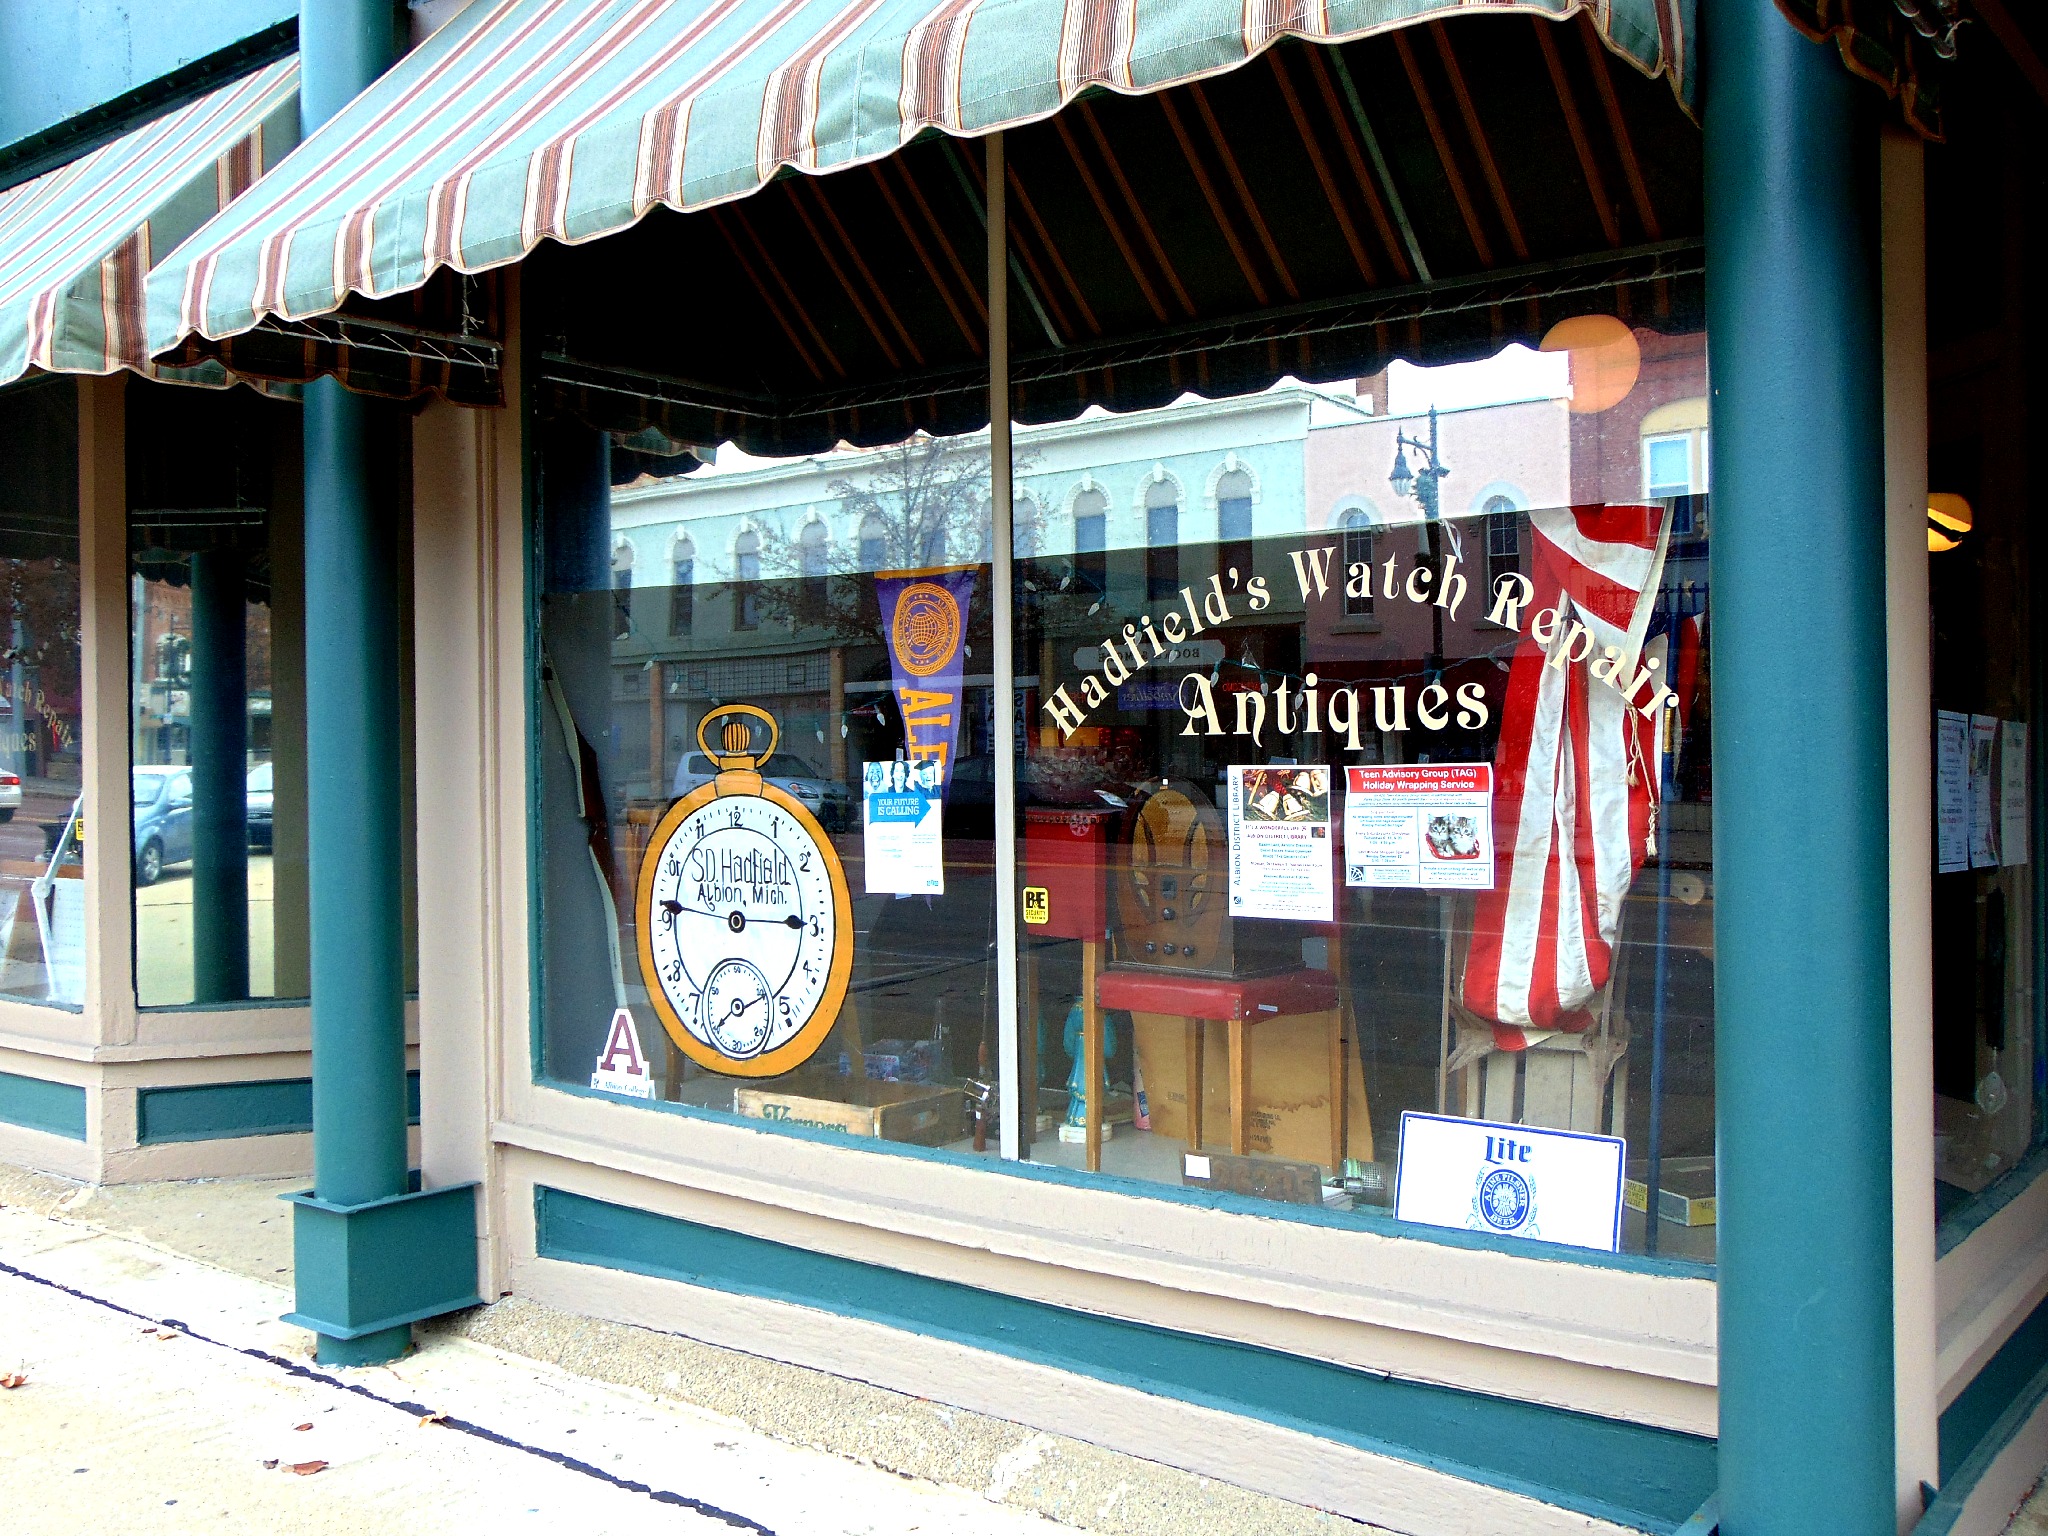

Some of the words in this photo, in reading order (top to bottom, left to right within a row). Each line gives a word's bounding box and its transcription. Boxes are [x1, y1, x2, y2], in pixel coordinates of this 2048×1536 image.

[1043, 567, 1271, 740] Hadfield's
[1287, 547, 1468, 622] Watch
[1484, 571, 1680, 722] Repair
[1178, 672, 1489, 751] Antiques
[1359, 770, 1380, 779] Teen
[1382, 770, 1420, 779] Advisory
[1421, 769, 1450, 778] Group
[1451, 769, 1477, 779] (TAG)
[1363, 780, 1394, 790] Holiday
[1396, 780, 1439, 790] Wrapping
[1440, 780, 1475, 789] Service
[877, 798, 893, 806] YOUR
[893, 798, 919, 806] FUTURE
[1232, 775, 1240, 811] LIBRARY
[729, 811, 744, 828] 12
[877, 806, 885, 816] IS
[885, 806, 920, 815] CALLING
[695, 823, 705, 840] 11
[771, 820, 778, 839] 1
[1232, 813, 1241, 851] DISTRICT
[721, 847, 792, 886] Hadfield
[799, 852, 811, 873] 2
[1233, 854, 1241, 886] ALBION
[697, 882, 747, 912] Albion,
[752, 881, 788, 905] Mich.
[661, 909, 673, 931] 9
[809, 914, 820, 938] 3
[672, 959, 682, 982] 8
[802, 959, 813, 979] 4
[688, 993, 701, 1016] 7
[779, 995, 791, 1016] 5
[753, 1026, 764, 1037] 20
[600, 1014, 643, 1076] A
[731, 1039, 743, 1051] 30
[1484, 1135, 1532, 1165] Lite
[1485, 1174, 1503, 1195] FINE
[1502, 1173, 1527, 1207] PILSNER
[1490, 1213, 1517, 1226] BEER
